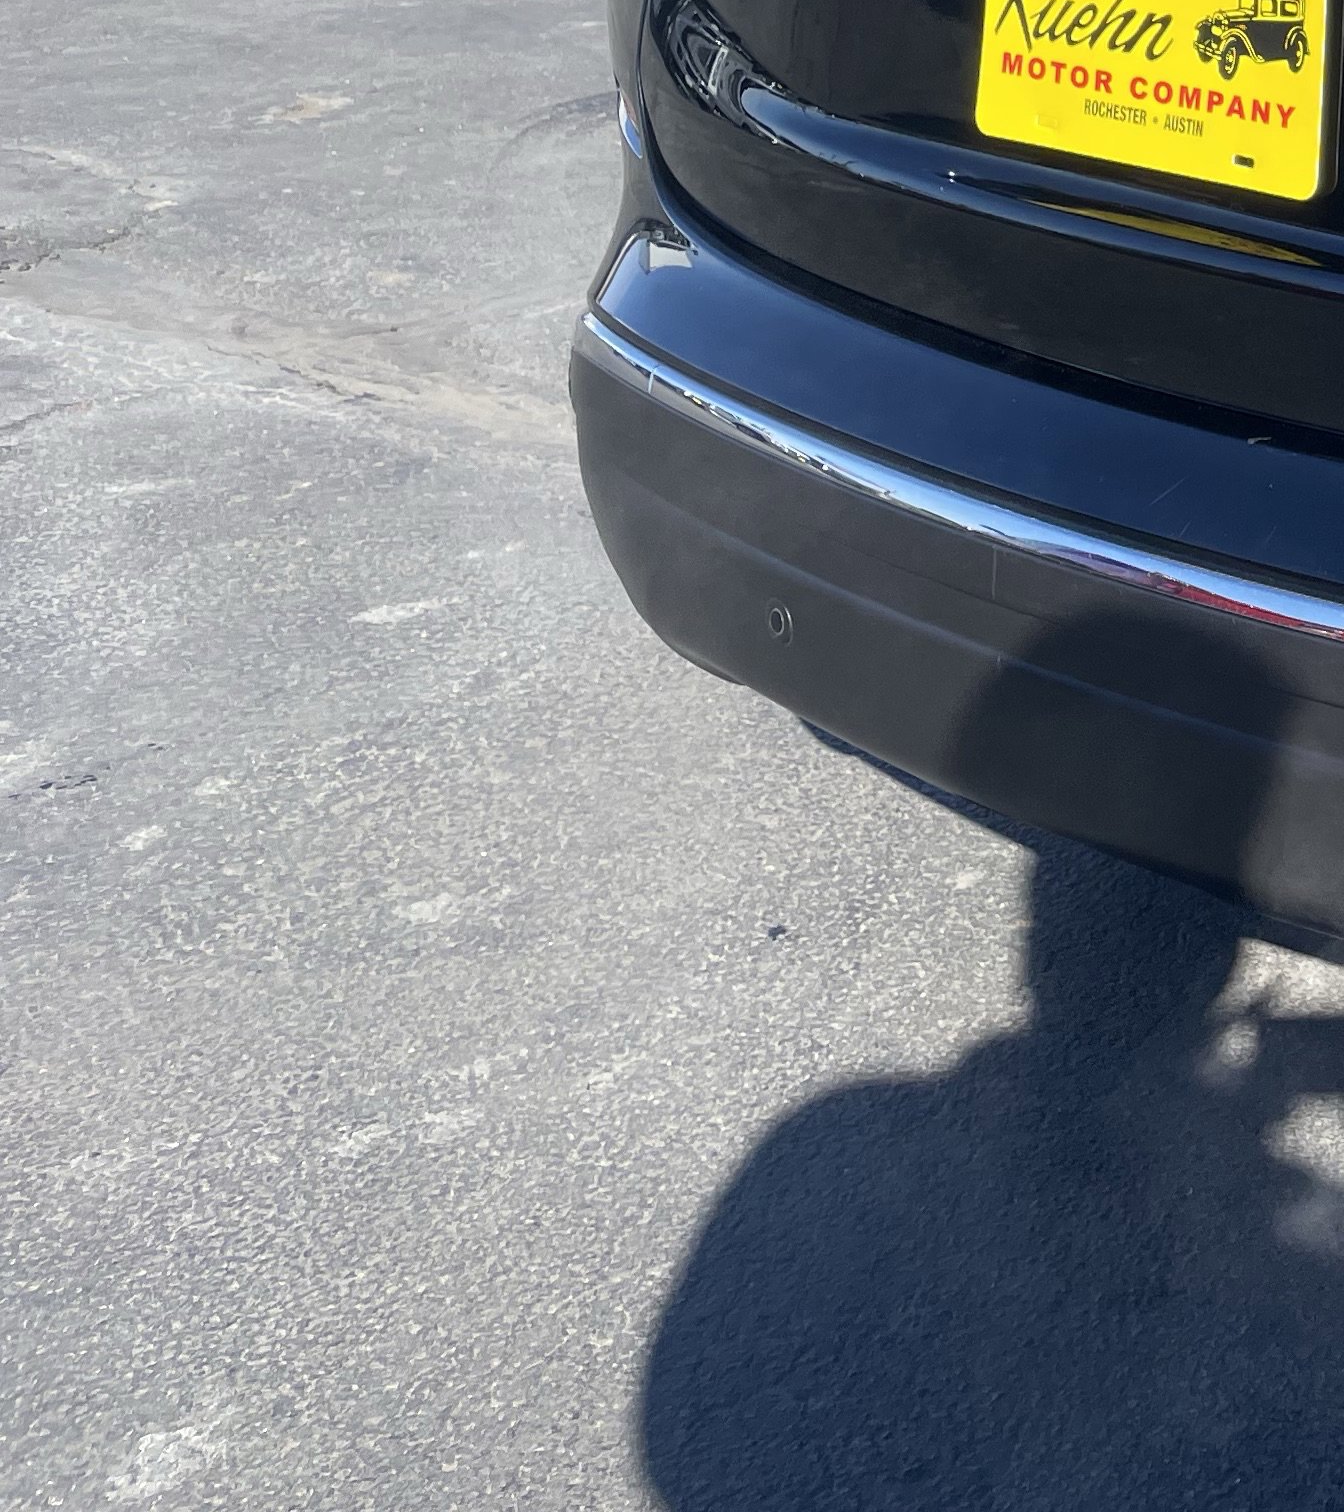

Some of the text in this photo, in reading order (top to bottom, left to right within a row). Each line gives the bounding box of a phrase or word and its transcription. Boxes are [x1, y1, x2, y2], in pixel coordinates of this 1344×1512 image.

[1001, 52, 1296, 129] MOTOR COMPANY
[1084, 98, 1204, 137] ROCHESTER AUSTIN
